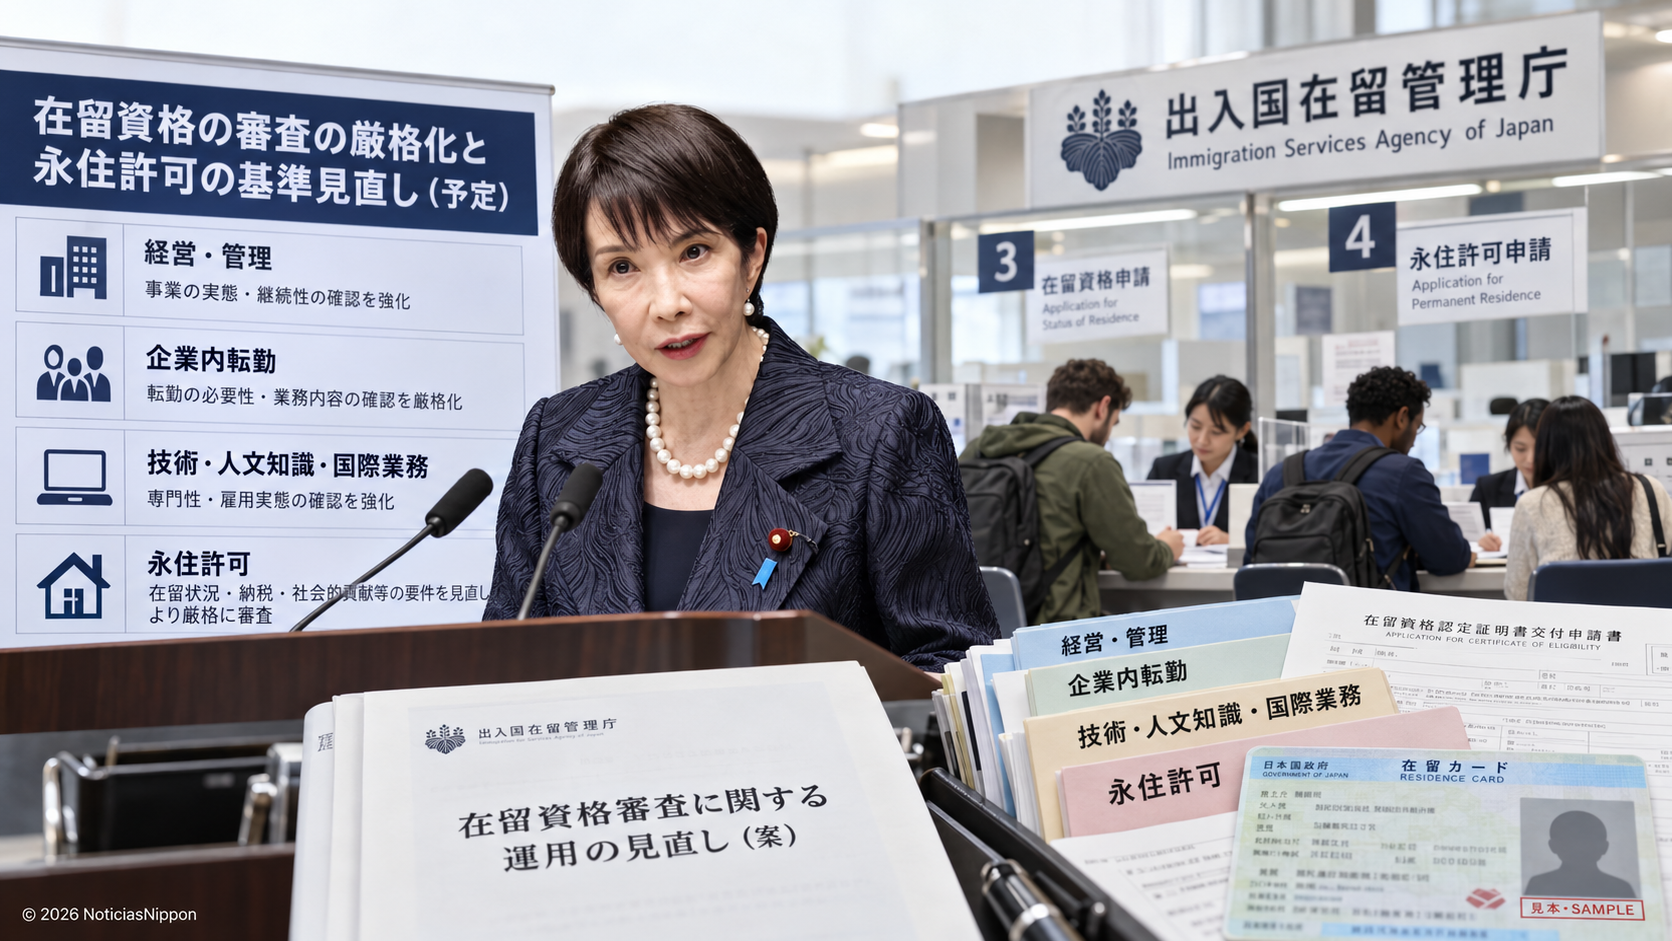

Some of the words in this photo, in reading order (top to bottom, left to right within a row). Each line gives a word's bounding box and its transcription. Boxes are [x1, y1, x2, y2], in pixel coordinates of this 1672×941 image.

[1165, 45, 1568, 140] 出入国在留管理庁
[33, 95, 487, 165] 在留資格の審査の厳格化と
[1168, 143, 1276, 170] Immigration
[1285, 135, 1366, 159] Services
[1375, 126, 1452, 152] Agency
[1465, 119, 1486, 140] of
[1496, 116, 1554, 141] Japan
[1345, 214, 1376, 259] 4
[144, 238, 272, 271] 経営・管理
[994, 241, 1018, 282] 3
[1410, 237, 1552, 271] 永住許可申請
[145, 281, 411, 311] 事業の実態・継続性の確認を強化
[1042, 266, 1151, 296] 在留資格申請
[1412, 275, 1482, 293] Application
[1487, 273, 1504, 285] for
[1042, 299, 1100, 315] Application
[1103, 298, 1118, 309] for
[1412, 294, 1476, 310] Permanent
[1480, 289, 1541, 304] Residence
[1042, 317, 1073, 331] Status
[1076, 316, 1086, 327] of
[1089, 311, 1139, 326] Residence
[146, 344, 276, 374] 企業内転勤
[146, 384, 463, 411] 転勤の必要性・業務内容の確認を厳格化
[147, 449, 429, 479] 技術・人文知識・国際業務
[147, 490, 395, 511] 専門性・雇用実態の確認を強化
[148, 550, 251, 577] 永住許可
[149, 605, 273, 625] より厳格に審査
[1364, 614, 1622, 643] 在留資格認定証明書交付申請書
[1061, 624, 1169, 657] 経営・管理
[1385, 631, 1442, 642] APPLICATION
[1469, 638, 1527, 648] CERTIFICATE
[1068, 659, 1188, 698] 企業内転勤
[478, 718, 617, 739] 出入国在留管理庁
[1077, 683, 1362, 749] 技術・人文知識・国際業務
[1264, 761, 1329, 770] 日本国政府
[1400, 773, 1466, 782] RESIDENCE
[1472, 775, 1505, 783] CARD
[1401, 759, 1508, 774] 在留カード
[1108, 761, 1223, 808] 永住許可
[458, 784, 828, 840] 在留資格審査に関する
